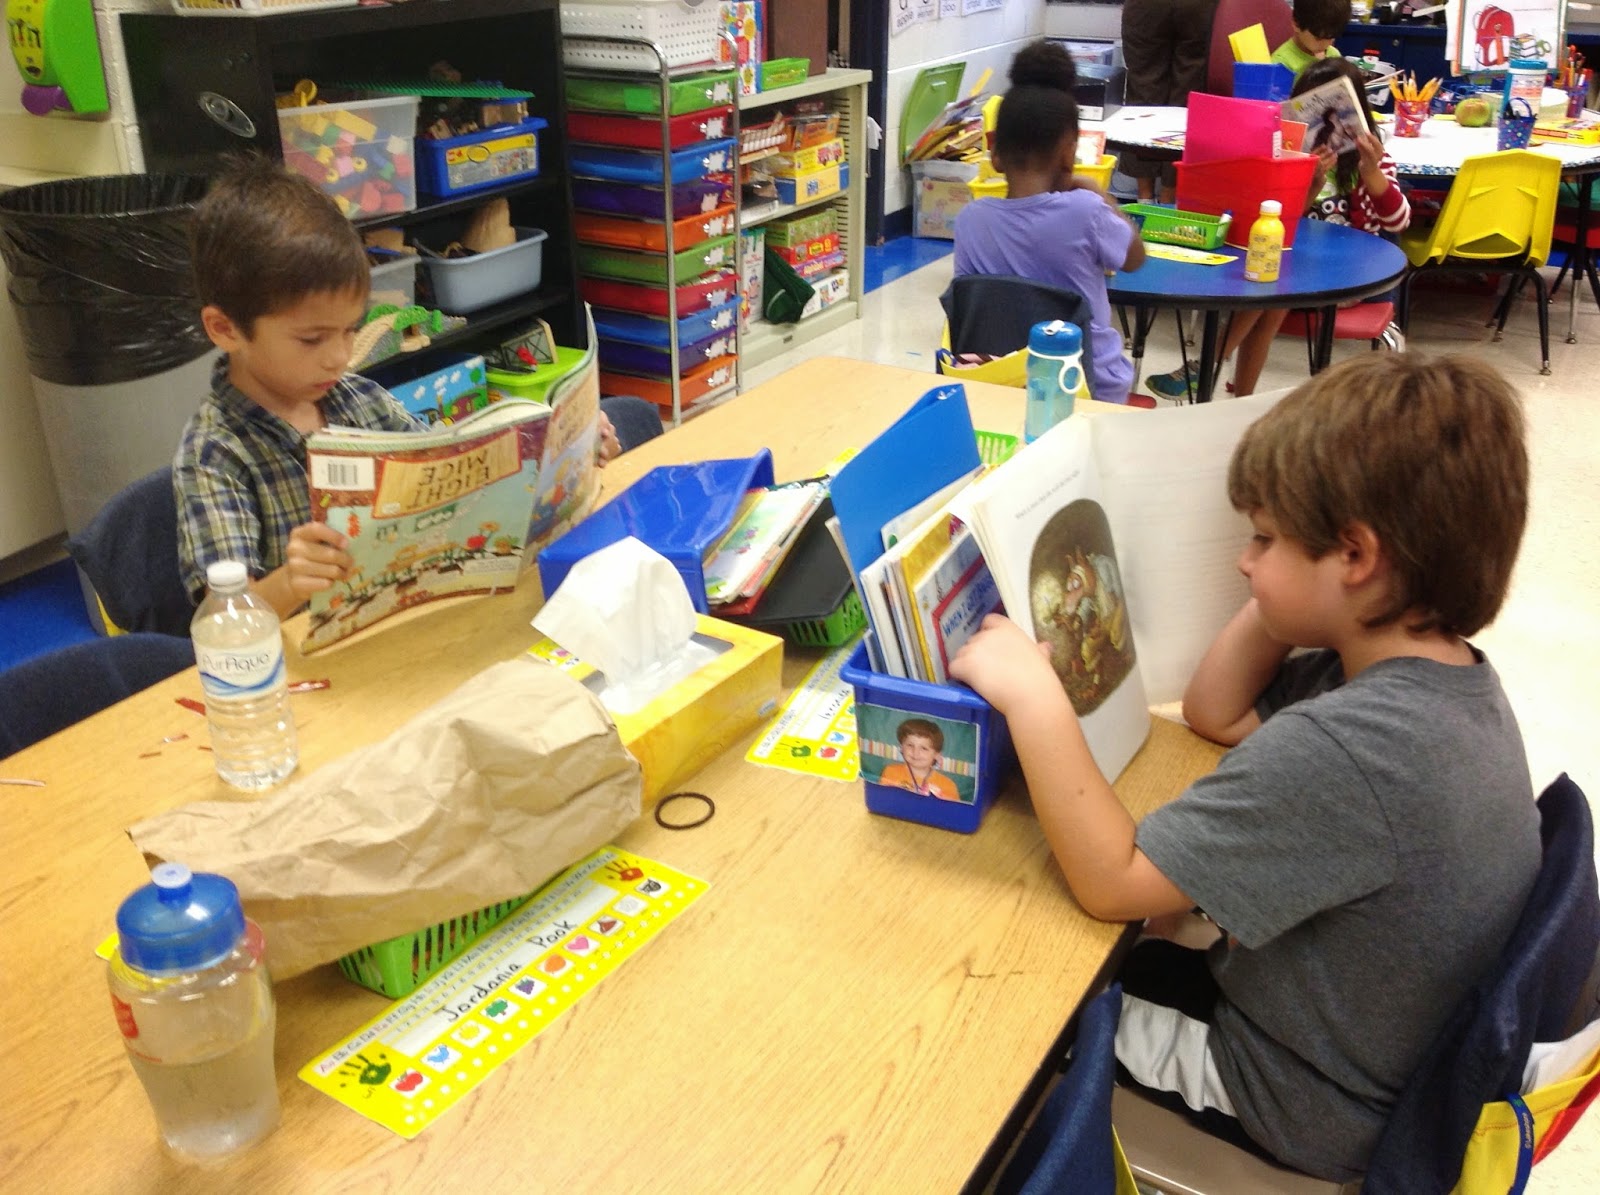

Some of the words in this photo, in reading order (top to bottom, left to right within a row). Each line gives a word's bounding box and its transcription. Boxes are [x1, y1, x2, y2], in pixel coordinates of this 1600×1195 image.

[406, 465, 490, 510] EIGHT
[418, 449, 488, 486] MICE
[203, 652, 270, 673] PurAqua
[433, 963, 522, 1023] Jordania
[526, 919, 578, 949] Pook
